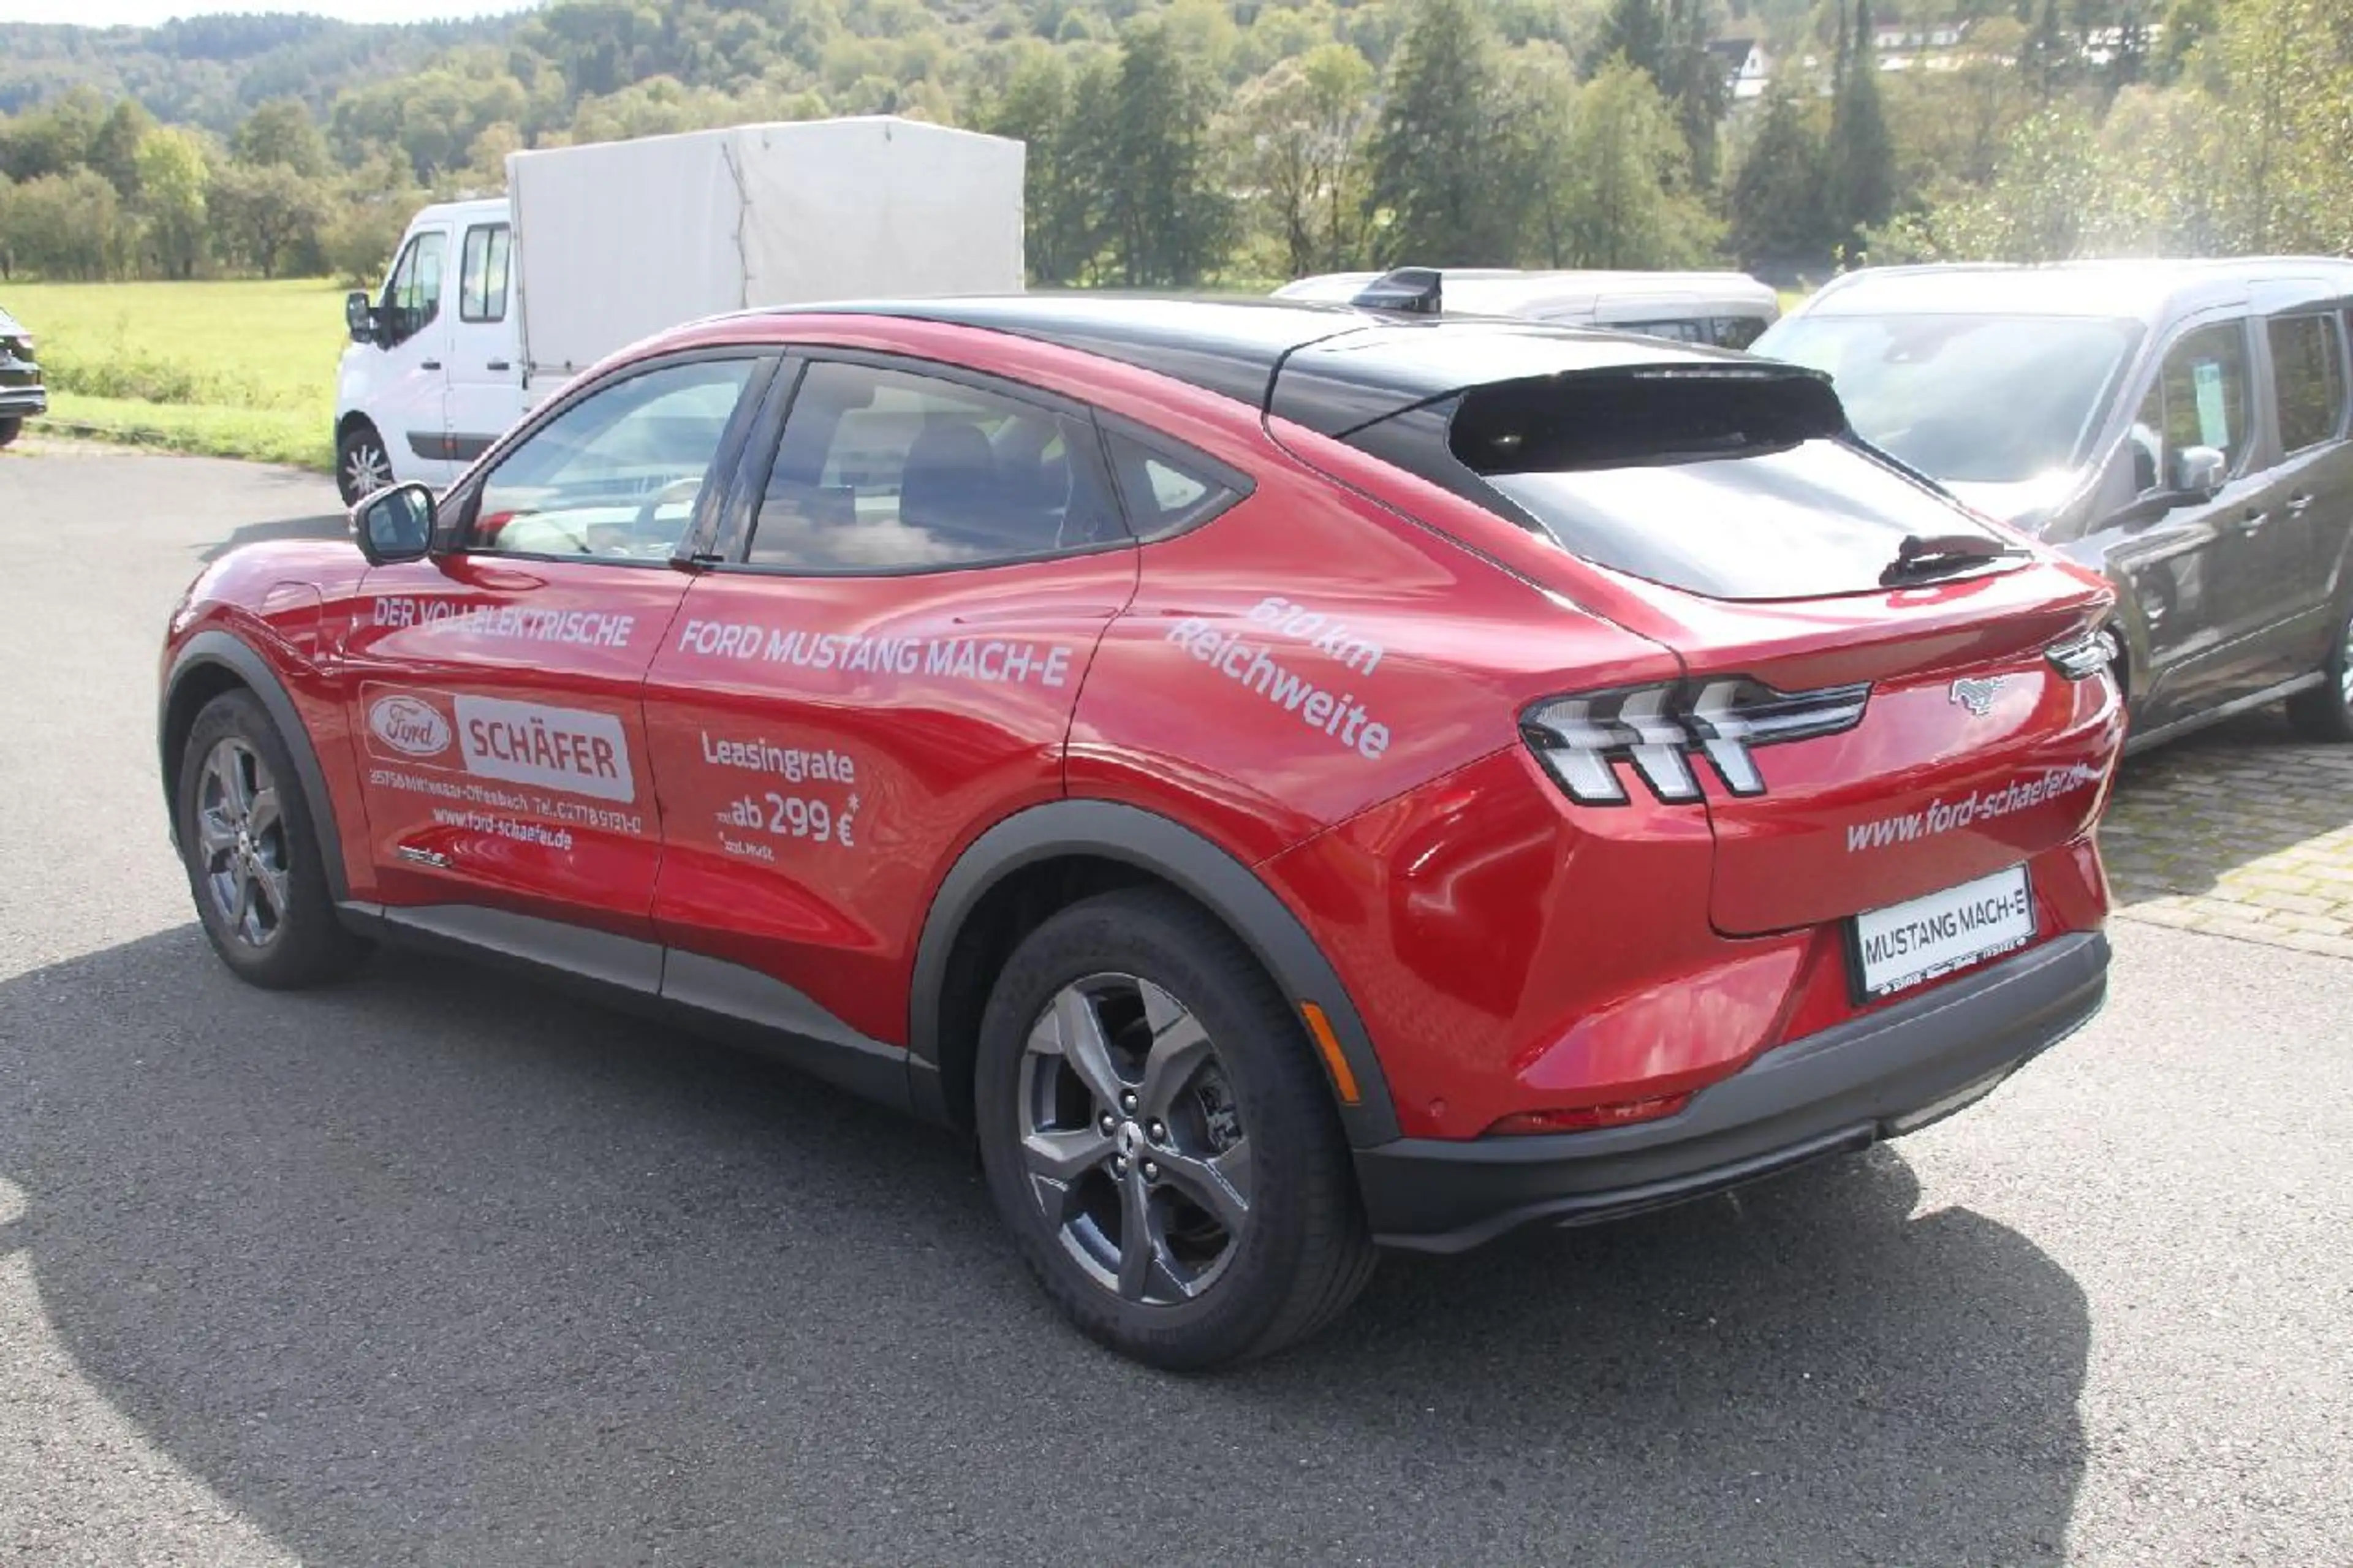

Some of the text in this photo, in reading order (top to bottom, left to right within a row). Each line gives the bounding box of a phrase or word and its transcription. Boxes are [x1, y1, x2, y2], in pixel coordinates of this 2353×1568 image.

[374, 597, 635, 647] DER VOLLELEKTRISCHE
[1246, 596, 1384, 676] 610 km
[678, 619, 1072, 688] FORD MUSTANG MACH-E
[1165, 615, 1390, 760] Reichweite
[385, 703, 434, 746] Ford
[469, 716, 618, 778] SCHÄFER
[701, 730, 854, 784] Leasingrate
[433, 806, 572, 850] www.ford-schaefer.de
[731, 794, 764, 830] ab
[765, 792, 830, 842] 299
[1865, 911, 1957, 965] MUSTANG
[1958, 888, 2025, 933] MACH-E
